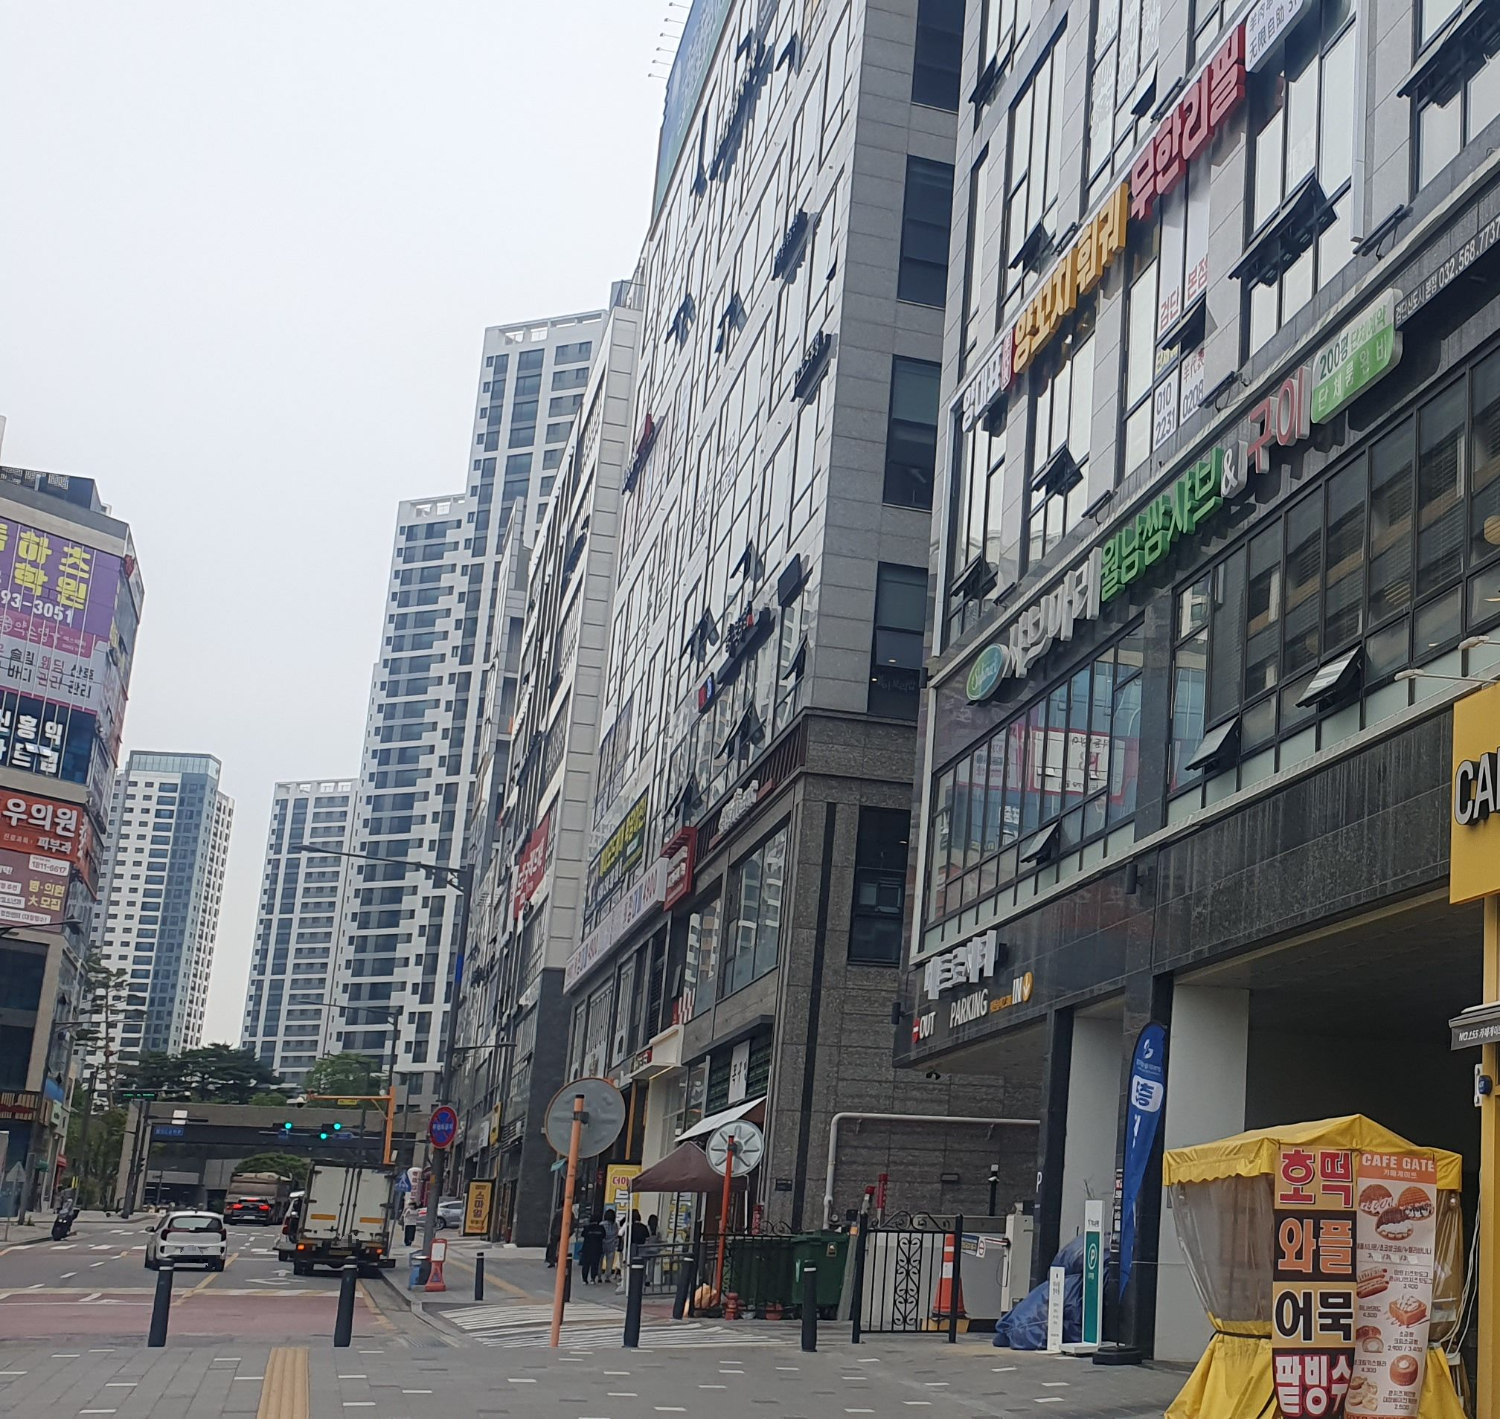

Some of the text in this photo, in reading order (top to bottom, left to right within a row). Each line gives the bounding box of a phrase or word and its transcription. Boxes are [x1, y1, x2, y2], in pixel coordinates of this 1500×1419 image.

[1013, 248, 1077, 374] 양꼬치
[1131, 22, 1246, 221] 무한리필
[1159, 254, 1208, 331] 검단 본점
[1156, 381, 1172, 417] 010
[1155, 405, 1176, 447] 2231
[1100, 446, 1226, 602] 월남쌈샤브
[1247, 365, 1312, 475] 구이
[37, 836, 72, 855] 피부과
[949, 988, 989, 1029] PARKING
[1012, 976, 1024, 1005] IN
[919, 1011, 937, 1040] OUT
[1362, 1153, 1435, 1172] CAFE GATE
[1276, 1217, 1354, 1275] 와플
[1274, 1289, 1354, 1342] 어묵
